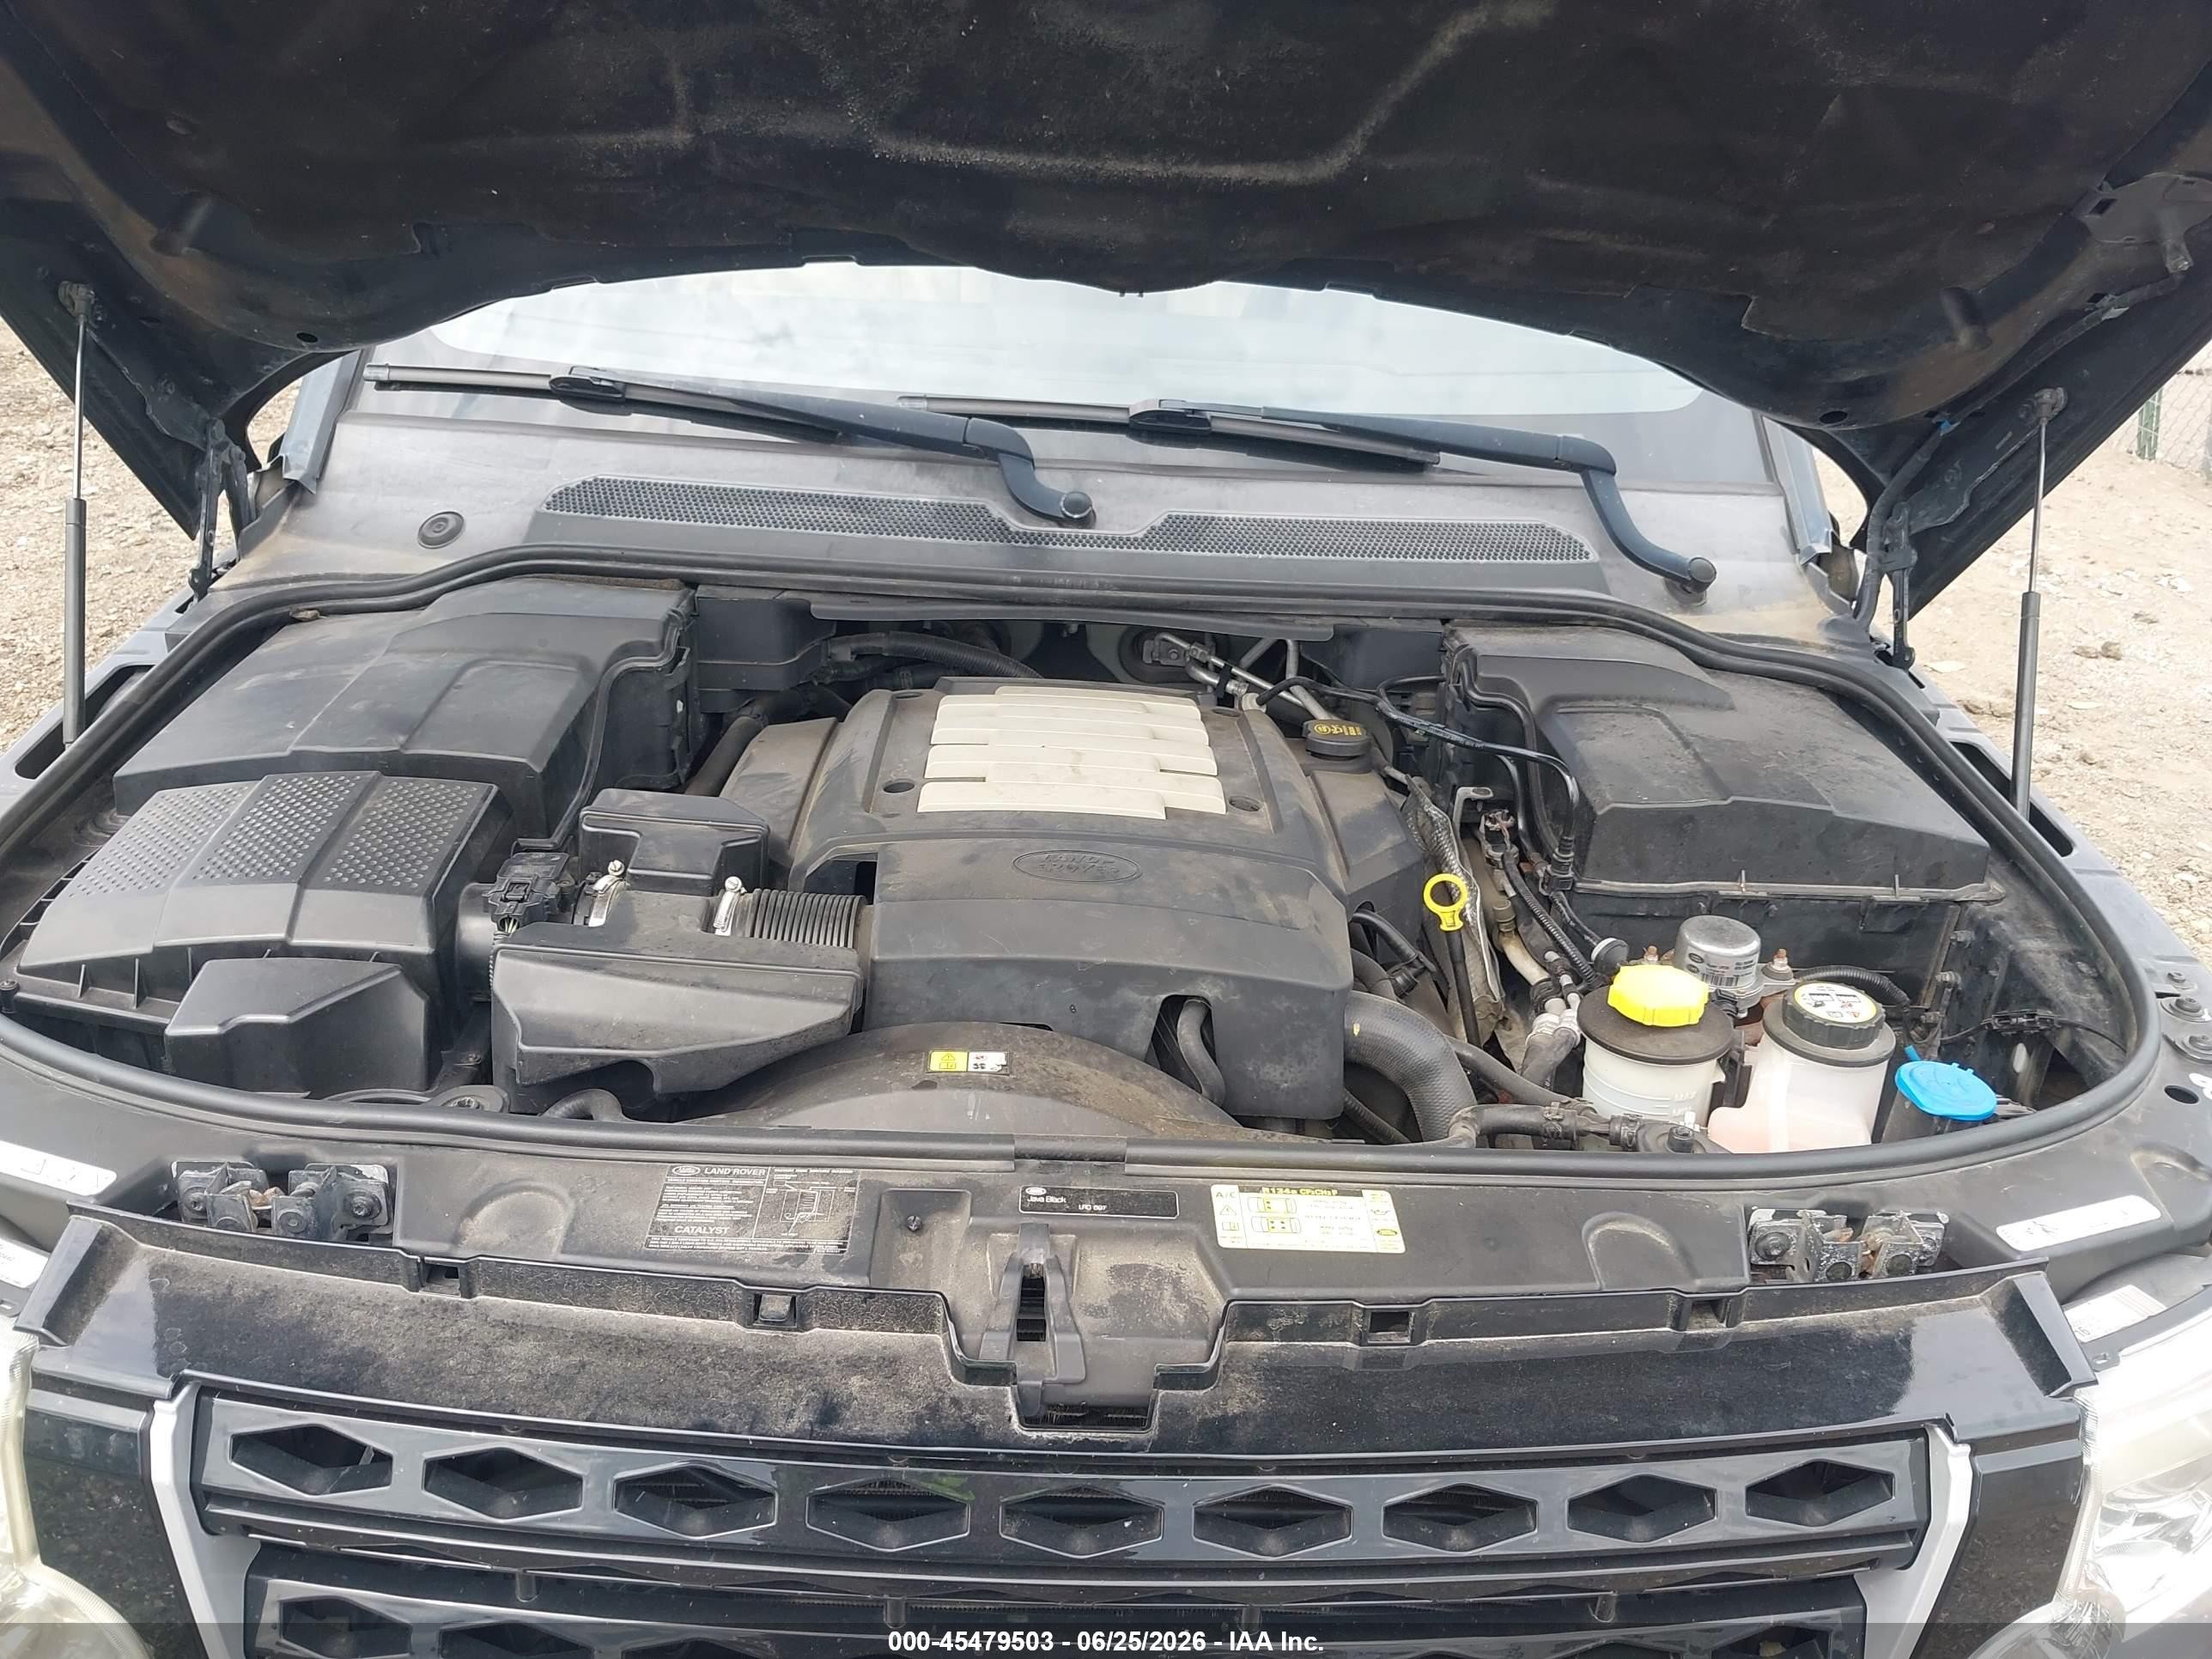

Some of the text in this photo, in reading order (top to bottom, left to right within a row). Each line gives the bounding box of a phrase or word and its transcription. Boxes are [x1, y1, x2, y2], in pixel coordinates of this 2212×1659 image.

[704, 1167, 731, 1176] LAND
[732, 1168, 766, 1176] ROVER
[1215, 1191, 1237, 1200] A/C
[674, 1225, 730, 1235] CATALYST
